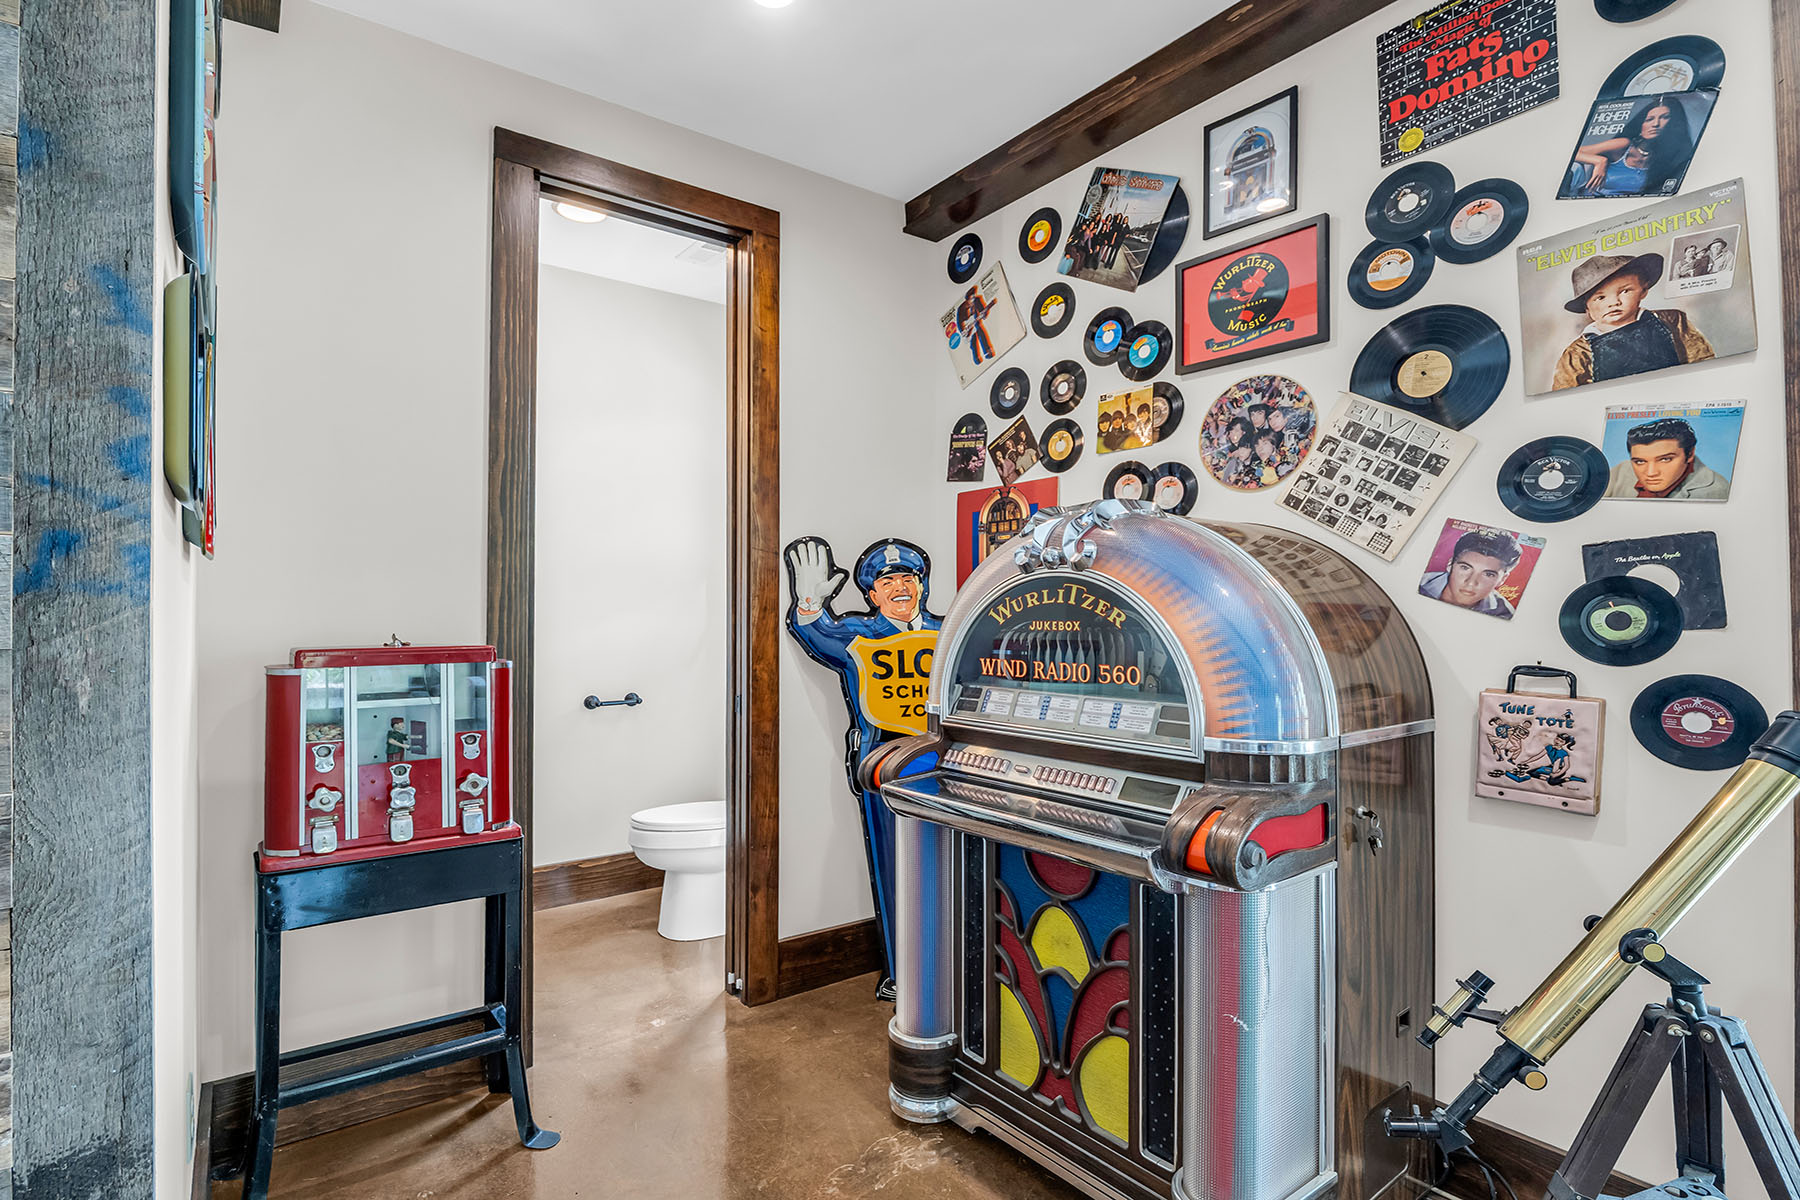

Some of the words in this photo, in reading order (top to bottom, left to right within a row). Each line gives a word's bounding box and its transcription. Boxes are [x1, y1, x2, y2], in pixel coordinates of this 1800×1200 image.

[1399, 37, 1424, 53] The
[1425, 11, 1481, 42] Million
[1431, 23, 1475, 50] Magic
[1478, 12, 1494, 28] of
[1424, 30, 1503, 81] Fats
[1388, 39, 1550, 125] Domino
[1592, 110, 1631, 123] HIGHER
[1587, 123, 1625, 136] HIGHER
[1526, 238, 1598, 272] "ELVIS
[1600, 198, 1733, 252] COUNTRY"
[1213, 255, 1276, 291] WURLITZER
[1224, 298, 1268, 313] PHONOGRAPH
[1227, 313, 1267, 332] MUSIC
[1607, 411, 1626, 420] ELVIS
[1627, 410, 1657, 419] PRESLEY
[1658, 409, 1684, 418] LOVING
[1686, 408, 1702, 417] YOU
[1344, 399, 1441, 450] ELVIS
[1627, 554, 1650, 562] Beatles
[1661, 551, 1681, 560] Apple
[988, 583, 1127, 629] WURLITZER
[1029, 620, 1081, 631] JUKEBOX
[871, 648, 934, 680] SLO
[979, 657, 1028, 678] WIND
[1033, 660, 1091, 683] RADIO
[1098, 663, 1141, 686] 560
[882, 684, 930, 699] SCH
[899, 704, 927, 718] ZO
[1498, 701, 1536, 716] TUNE
[1673, 702, 1722, 718] Brunswick
[1535, 716, 1575, 729] TOTE
